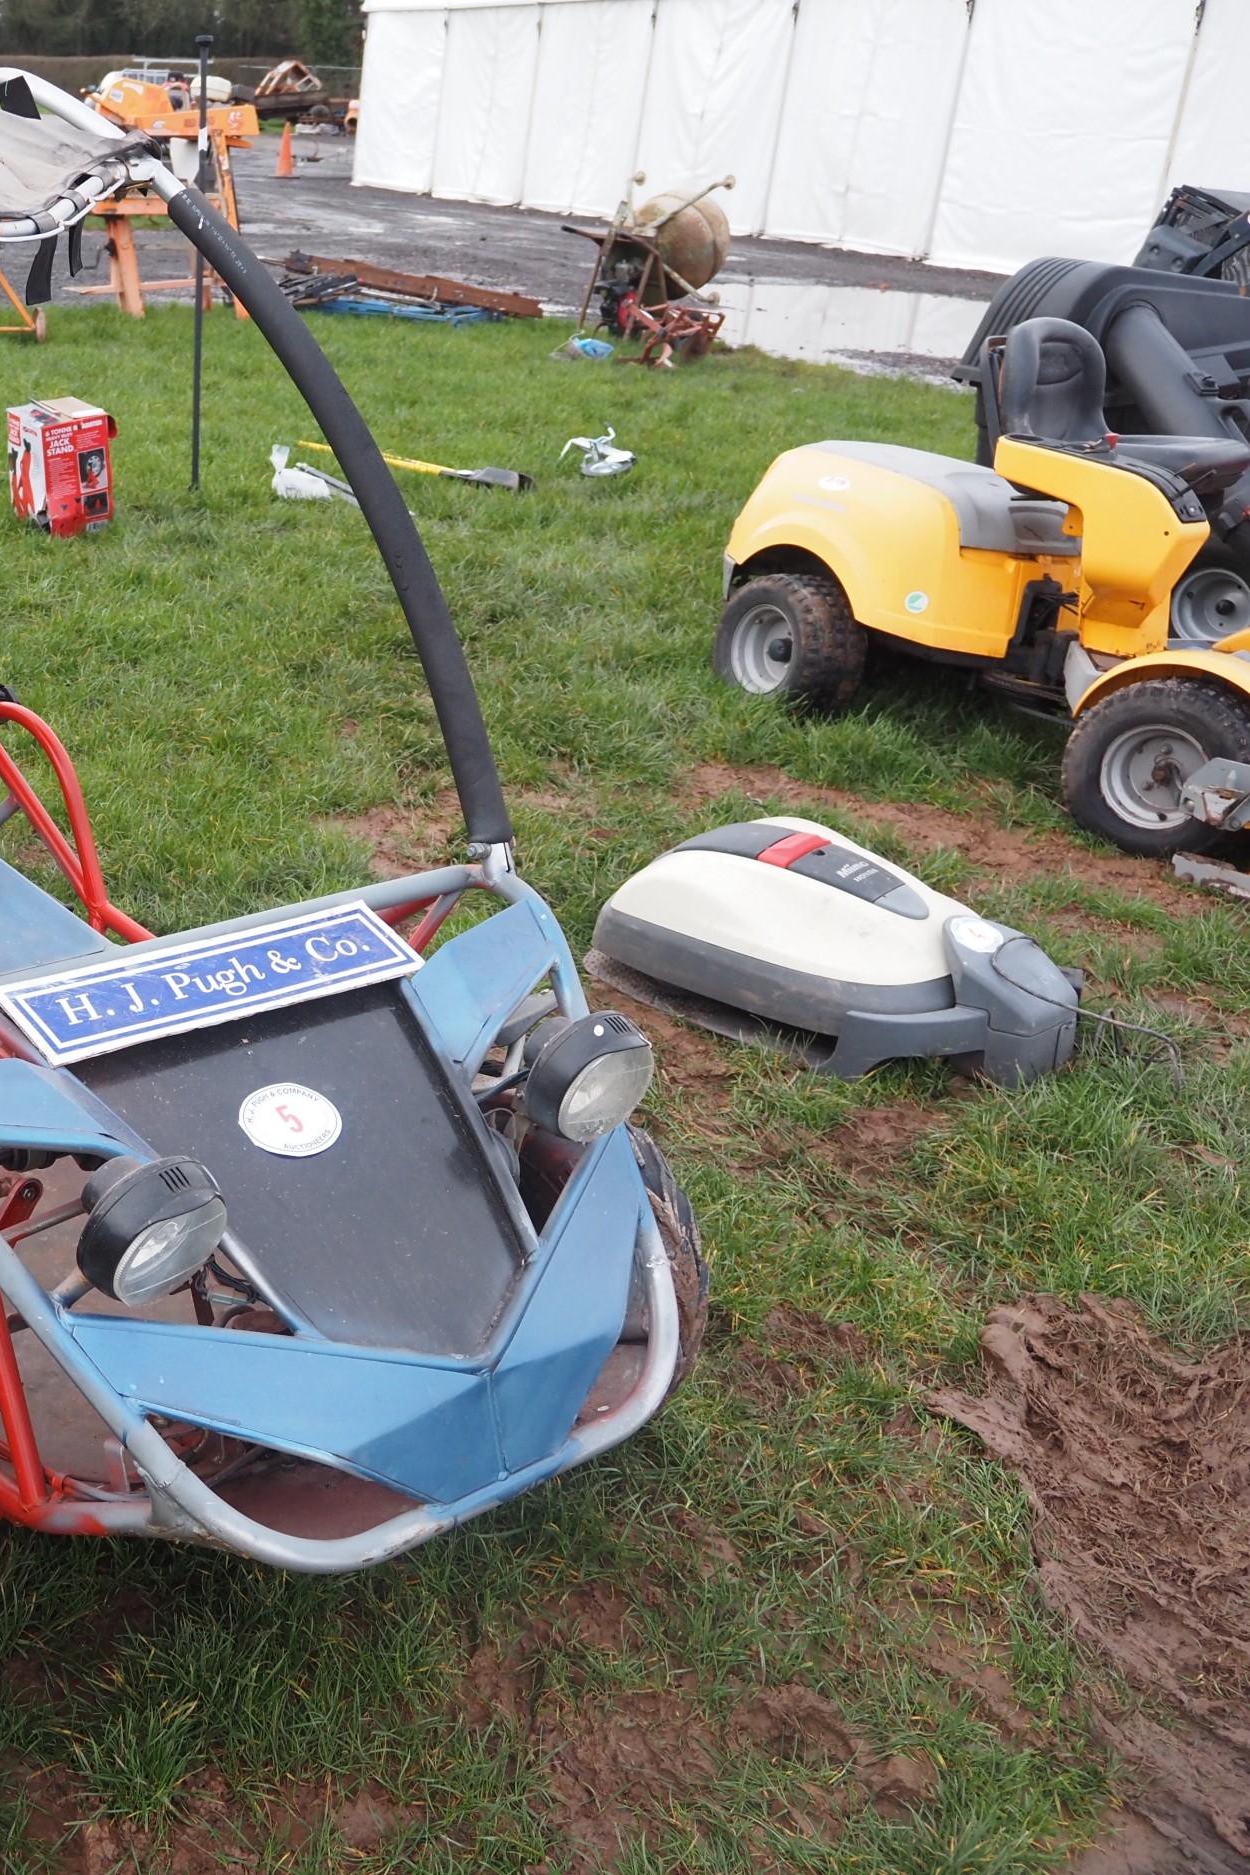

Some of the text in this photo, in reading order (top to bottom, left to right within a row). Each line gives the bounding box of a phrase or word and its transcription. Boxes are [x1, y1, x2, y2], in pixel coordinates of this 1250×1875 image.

[51, 425, 72, 435] TONNE
[47, 445, 74, 457] STAND
[49, 438, 70, 449] JACK
[55, 935, 371, 1026] H. J. Pugh & Co.
[251, 1093, 269, 1108] PUGH
[276, 1087, 319, 1102] COMPANY
[275, 1104, 304, 1133] 5
[283, 1128, 331, 1150] AUCTIONEERS
